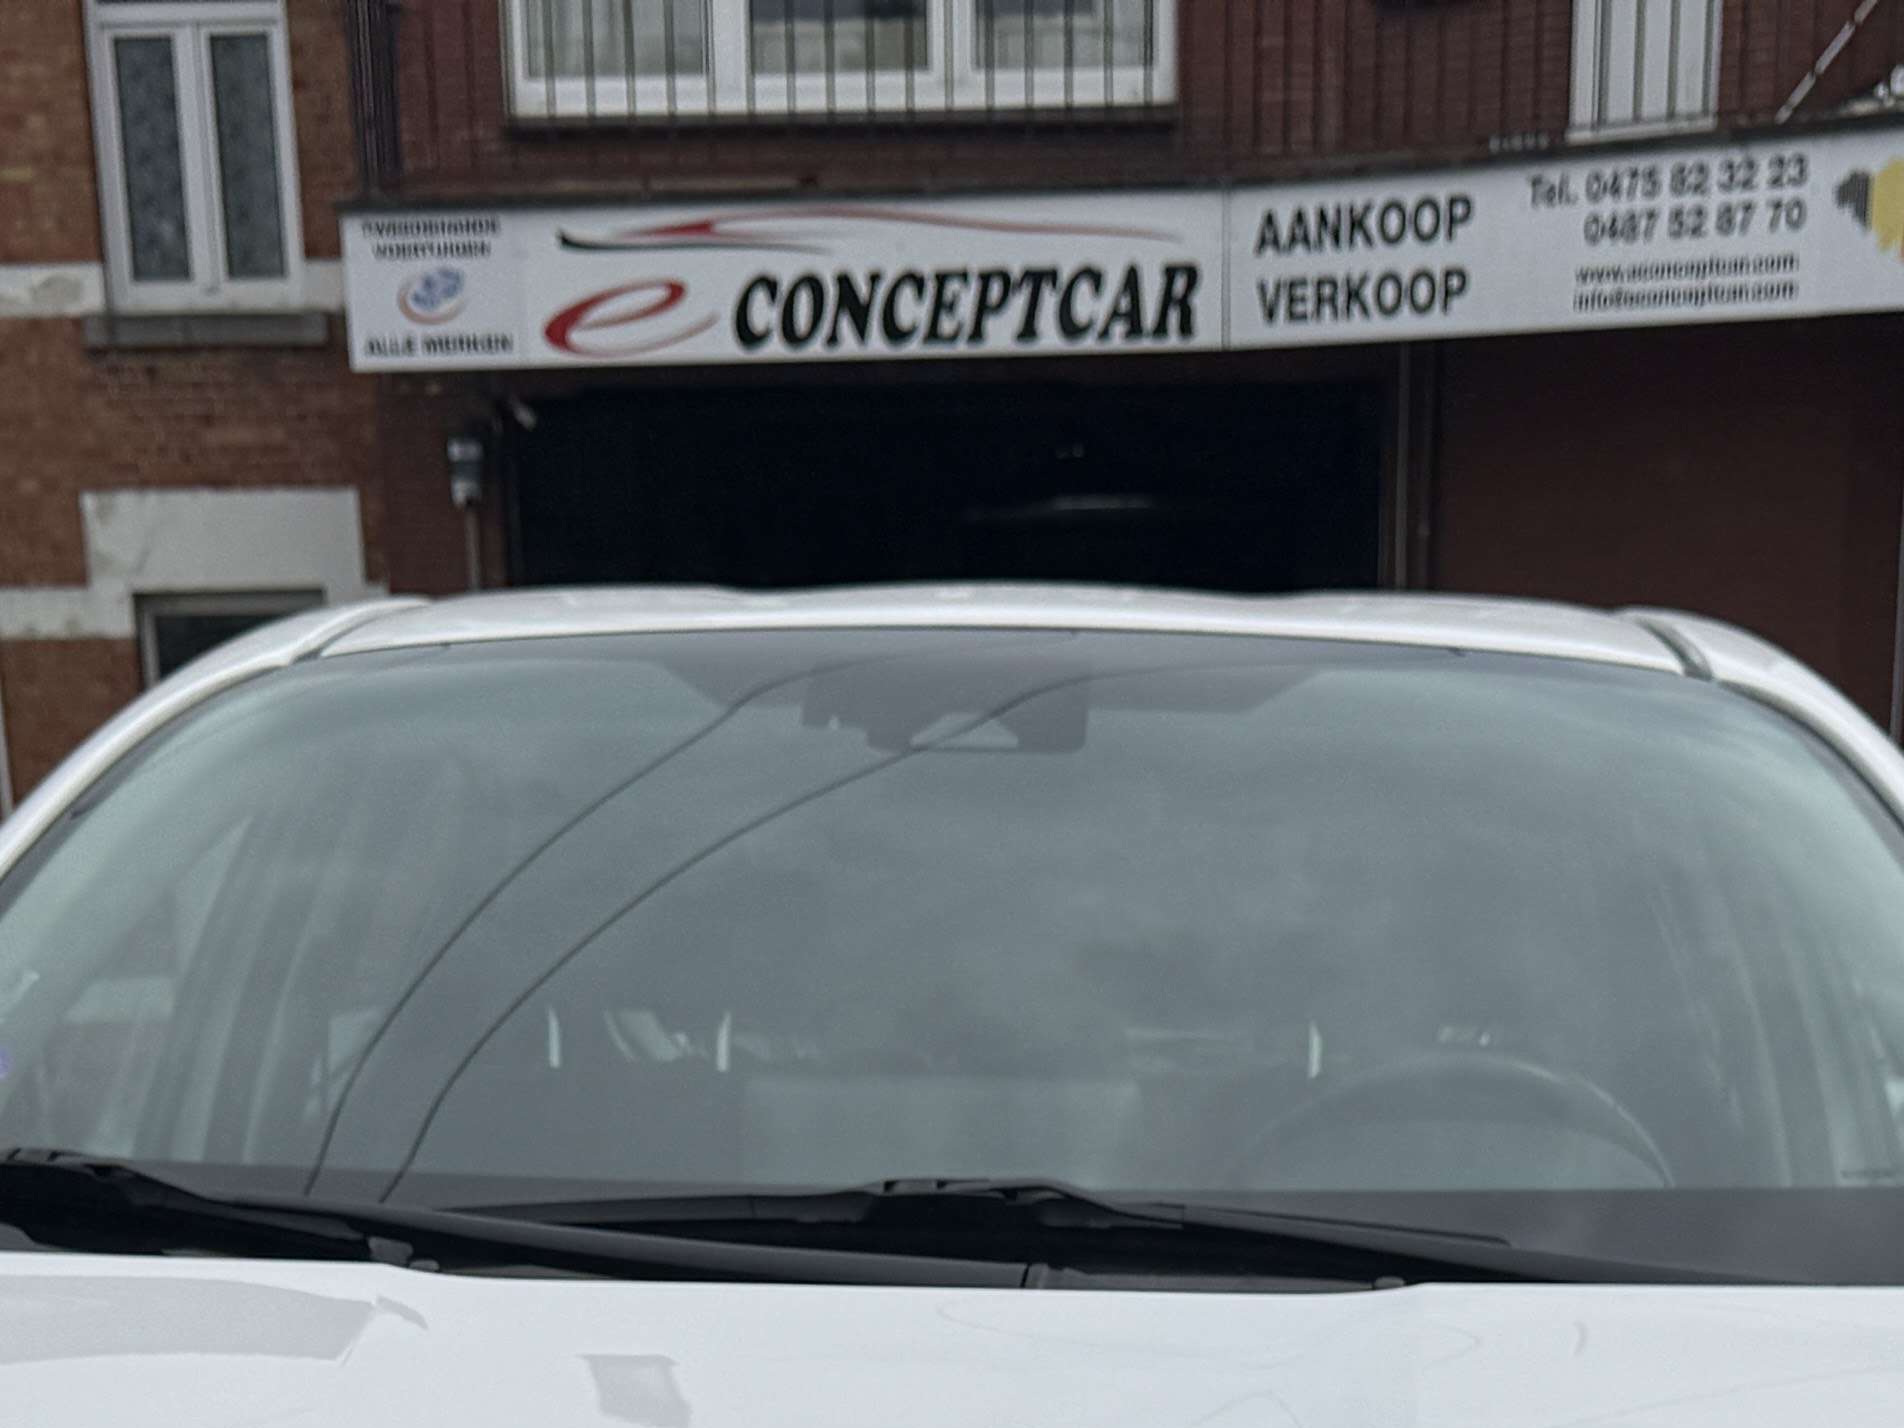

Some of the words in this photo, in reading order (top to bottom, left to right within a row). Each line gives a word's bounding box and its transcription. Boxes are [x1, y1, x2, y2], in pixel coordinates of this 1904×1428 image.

[1529, 171, 1579, 208] Tel.
[1585, 163, 1661, 202] 0475
[1669, 160, 1711, 198] 82
[1717, 154, 1759, 193] 32
[1767, 152, 1809, 189] 23
[1254, 193, 1473, 257] AANKOOP
[1667, 202, 1709, 240] 52
[1765, 197, 1807, 234] 70
[734, 262, 1200, 350] CONCEPTCAR
[1257, 265, 1469, 326] VERKOOP
